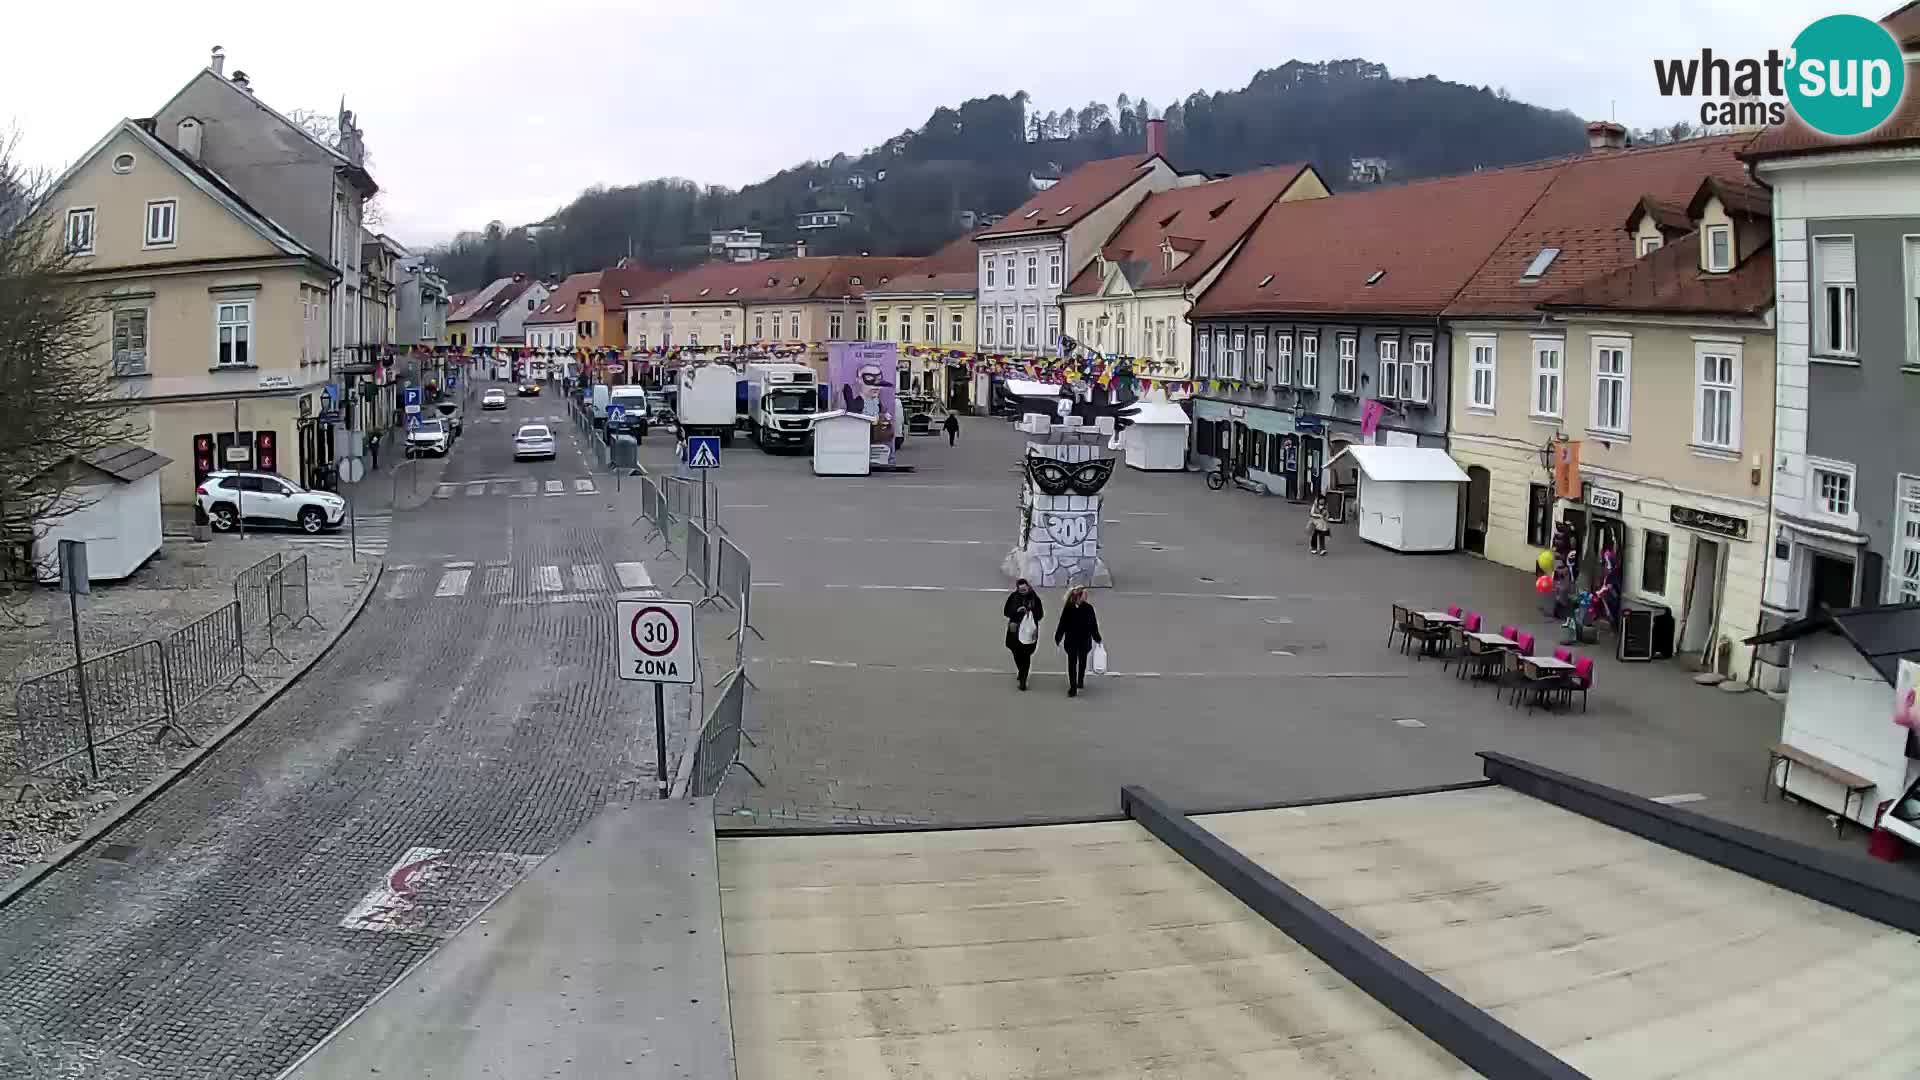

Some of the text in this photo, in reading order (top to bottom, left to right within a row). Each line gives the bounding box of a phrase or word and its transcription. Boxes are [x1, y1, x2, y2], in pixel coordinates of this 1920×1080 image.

[408, 392, 416, 403] P
[1048, 516, 1087, 545] 200
[644, 622, 667, 643] 30
[634, 659, 678, 676] ZONA
